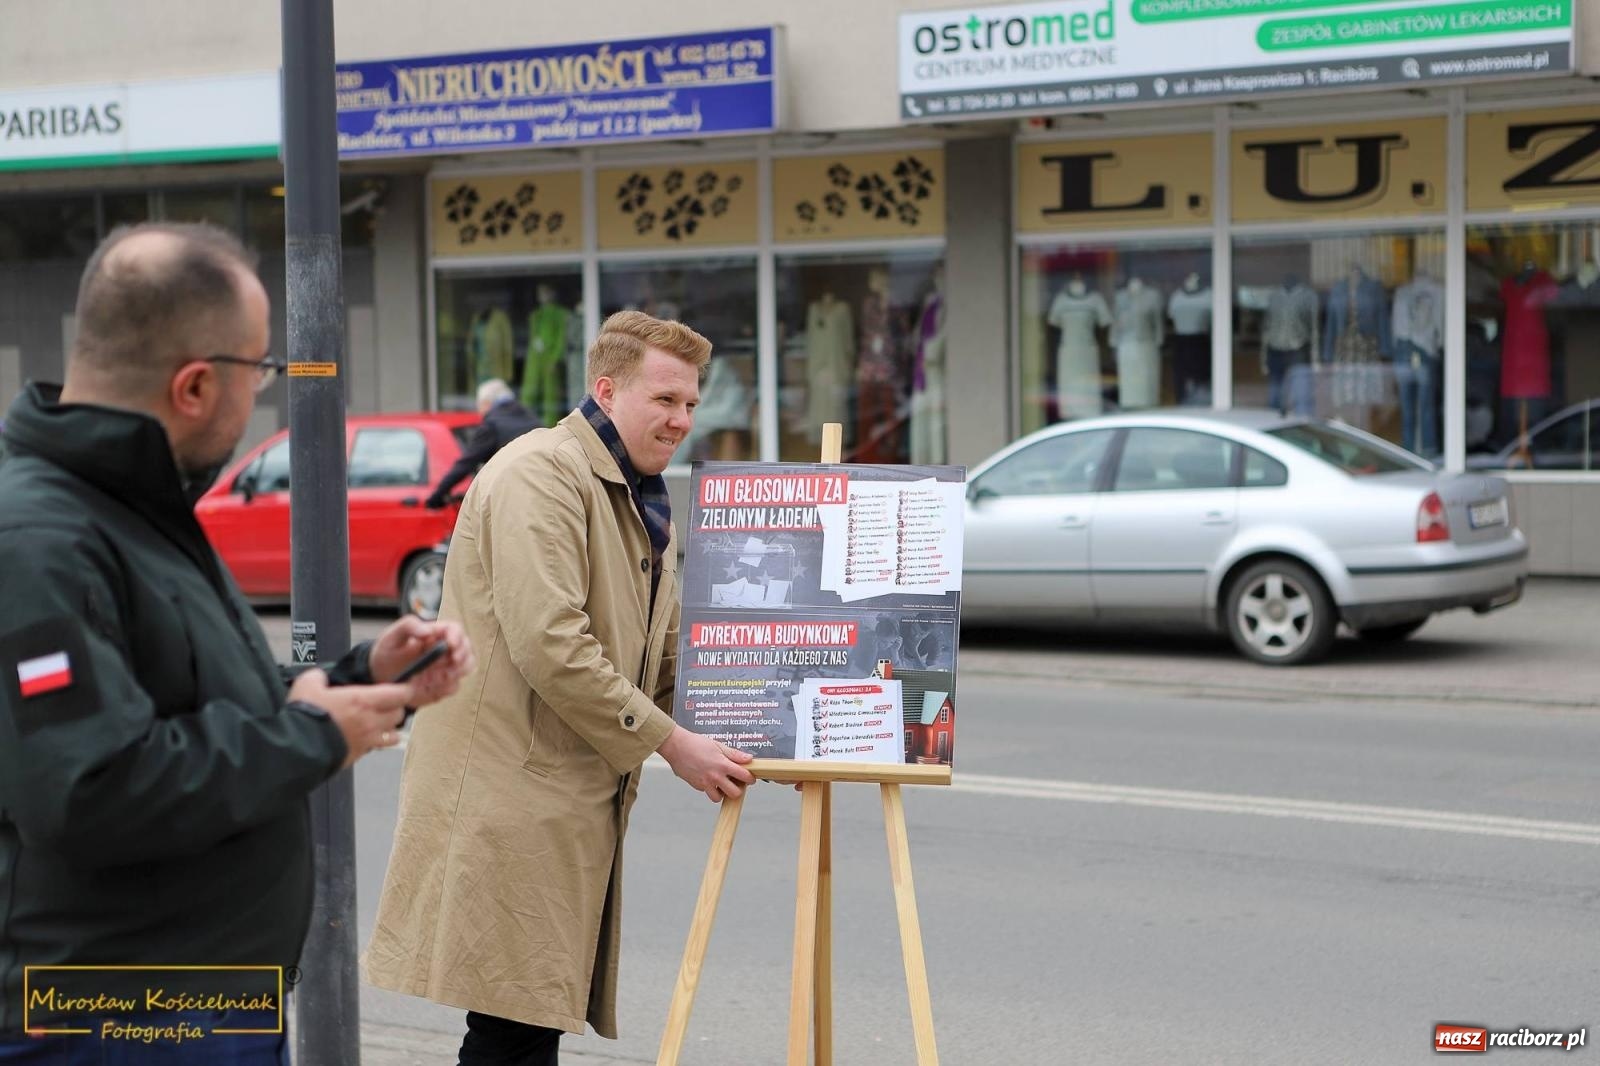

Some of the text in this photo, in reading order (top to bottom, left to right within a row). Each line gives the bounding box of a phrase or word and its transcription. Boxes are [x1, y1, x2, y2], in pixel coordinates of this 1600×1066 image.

[914, 0, 1115, 55] ostromed
[1271, 5, 1561, 44] ZESPÓŁ GABINETÓW LEKARSKICH
[914, 47, 1117, 80] CENTRUM MEDYCZNE
[1430, 50, 1550, 76] www.ostromed.pl
[397, 44, 647, 102] NIERUCHOMOŚCI
[704, 477, 843, 504] ONI GŁOSOWALI ZA
[701, 507, 818, 529] ZIELONYM ŁADEM!
[697, 649, 848, 666] NOWE WYDATKI DLA KAŻDEGO Z NAS
[686, 687, 766, 697] przepisy narzucające:
[727, 679, 765, 688] Europejski
[766, 679, 792, 688] przyjął
[695, 700, 779, 709] obowiązek montowania
[695, 711, 717, 719] paneli
[705, 718, 729, 726] niemal
[730, 718, 758, 727] każdym
[758, 718, 783, 726] dachu.
[739, 731, 763, 740] pieców
[737, 740, 773, 749] gazowych.
